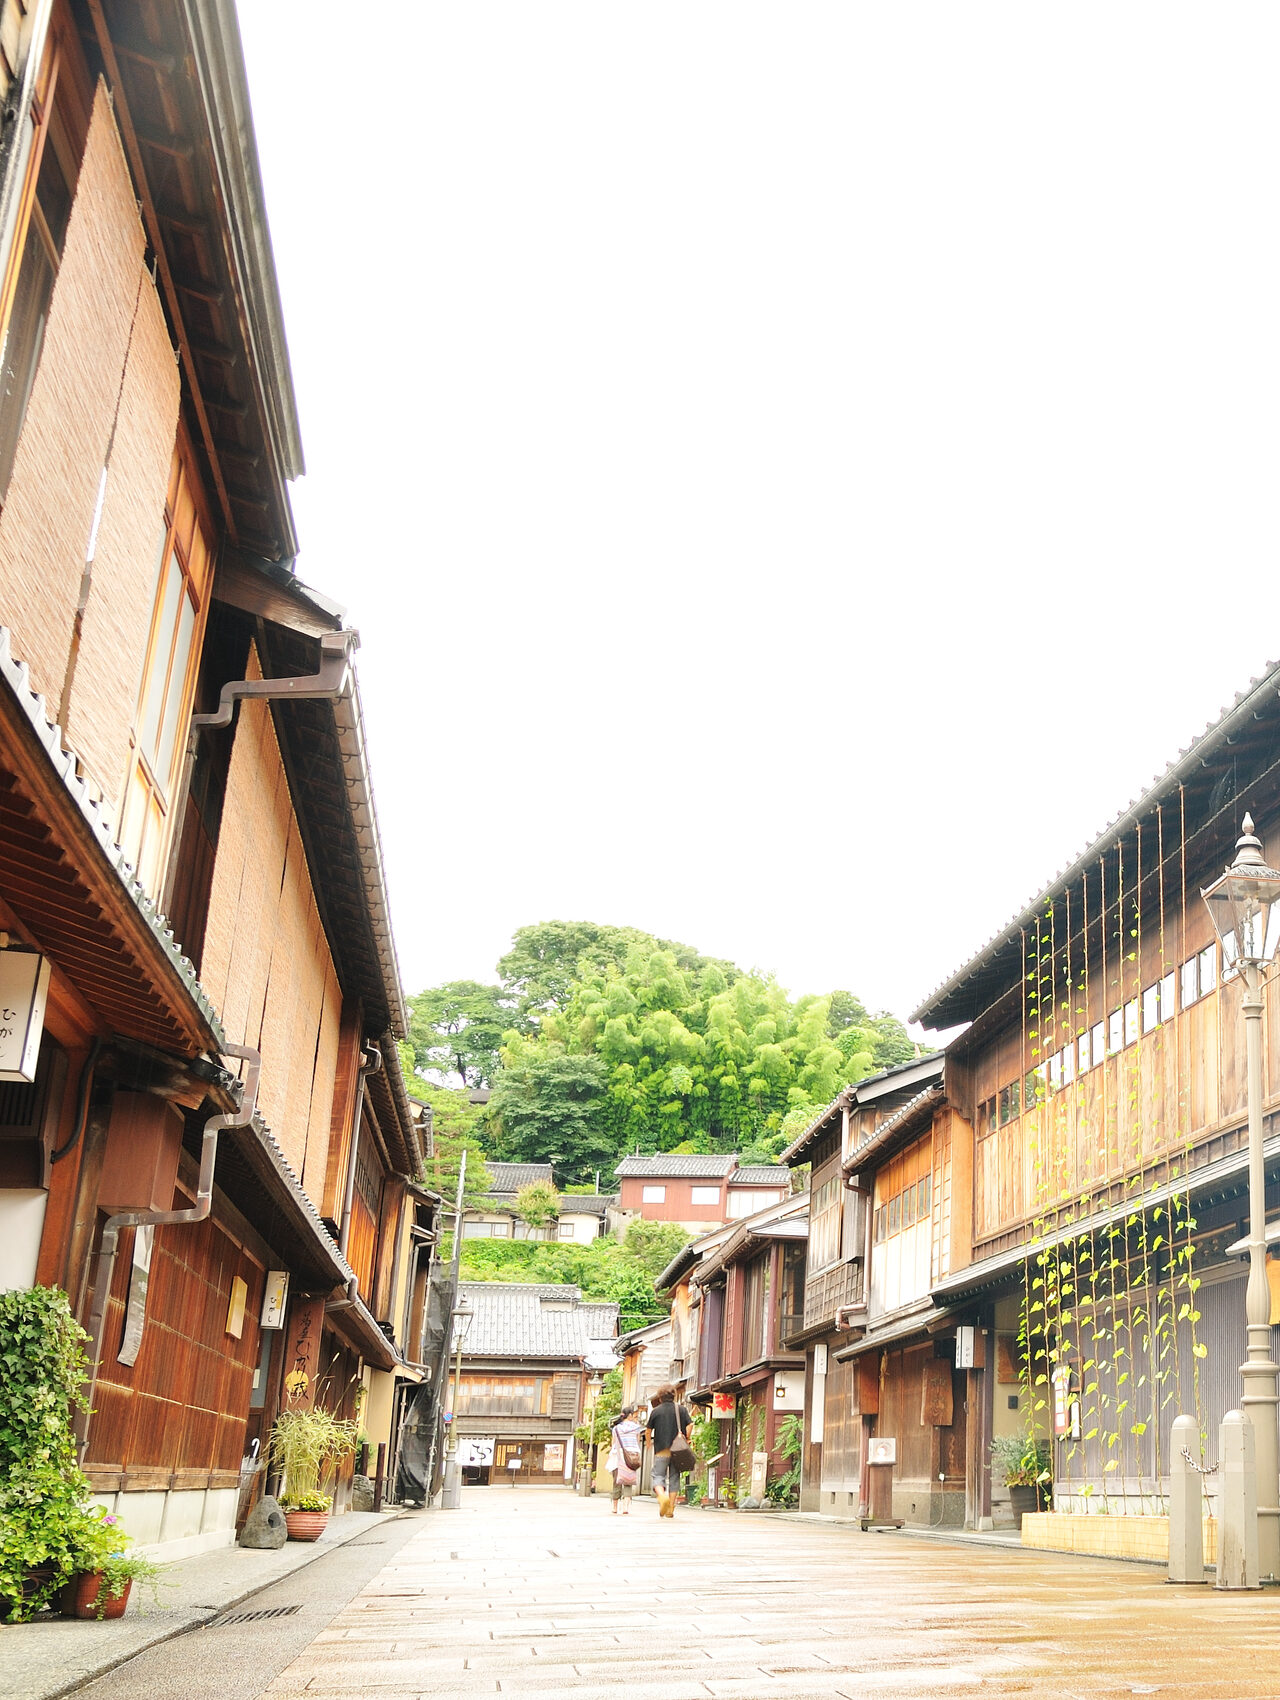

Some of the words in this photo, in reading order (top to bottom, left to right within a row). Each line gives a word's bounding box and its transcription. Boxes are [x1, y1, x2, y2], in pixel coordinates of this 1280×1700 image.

[268, 1296, 277, 1323] ひがし
[714, 1393, 734, 1412] 氷
